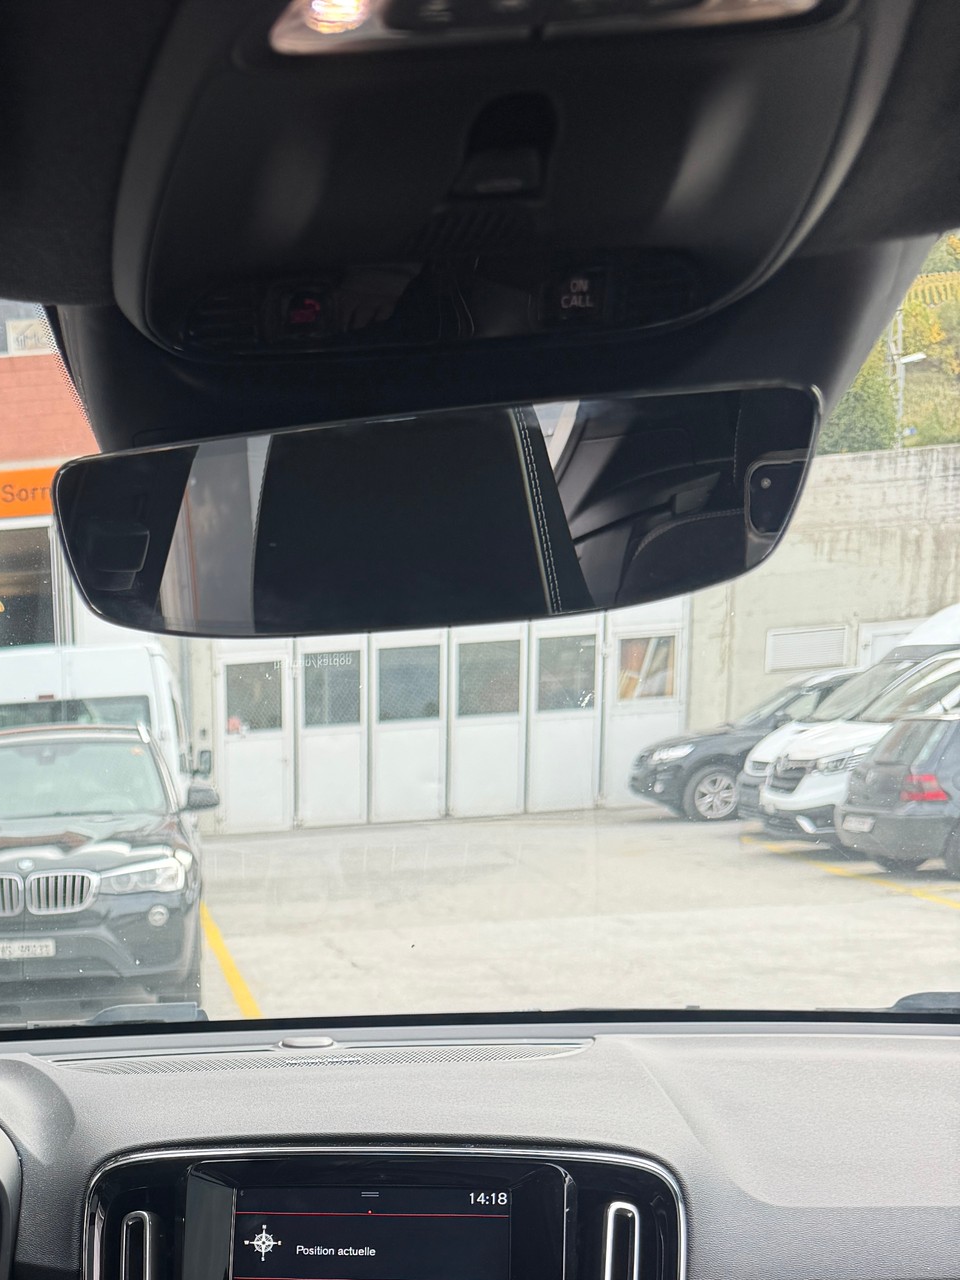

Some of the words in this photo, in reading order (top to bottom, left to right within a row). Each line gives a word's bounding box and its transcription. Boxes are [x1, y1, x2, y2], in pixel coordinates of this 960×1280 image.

[570, 279, 589, 293] ON
[561, 295, 594, 309] CALL
[469, 1192, 508, 1205] 14:18
[296, 1245, 335, 1256] Position
[337, 1246, 376, 1257] actuelle
